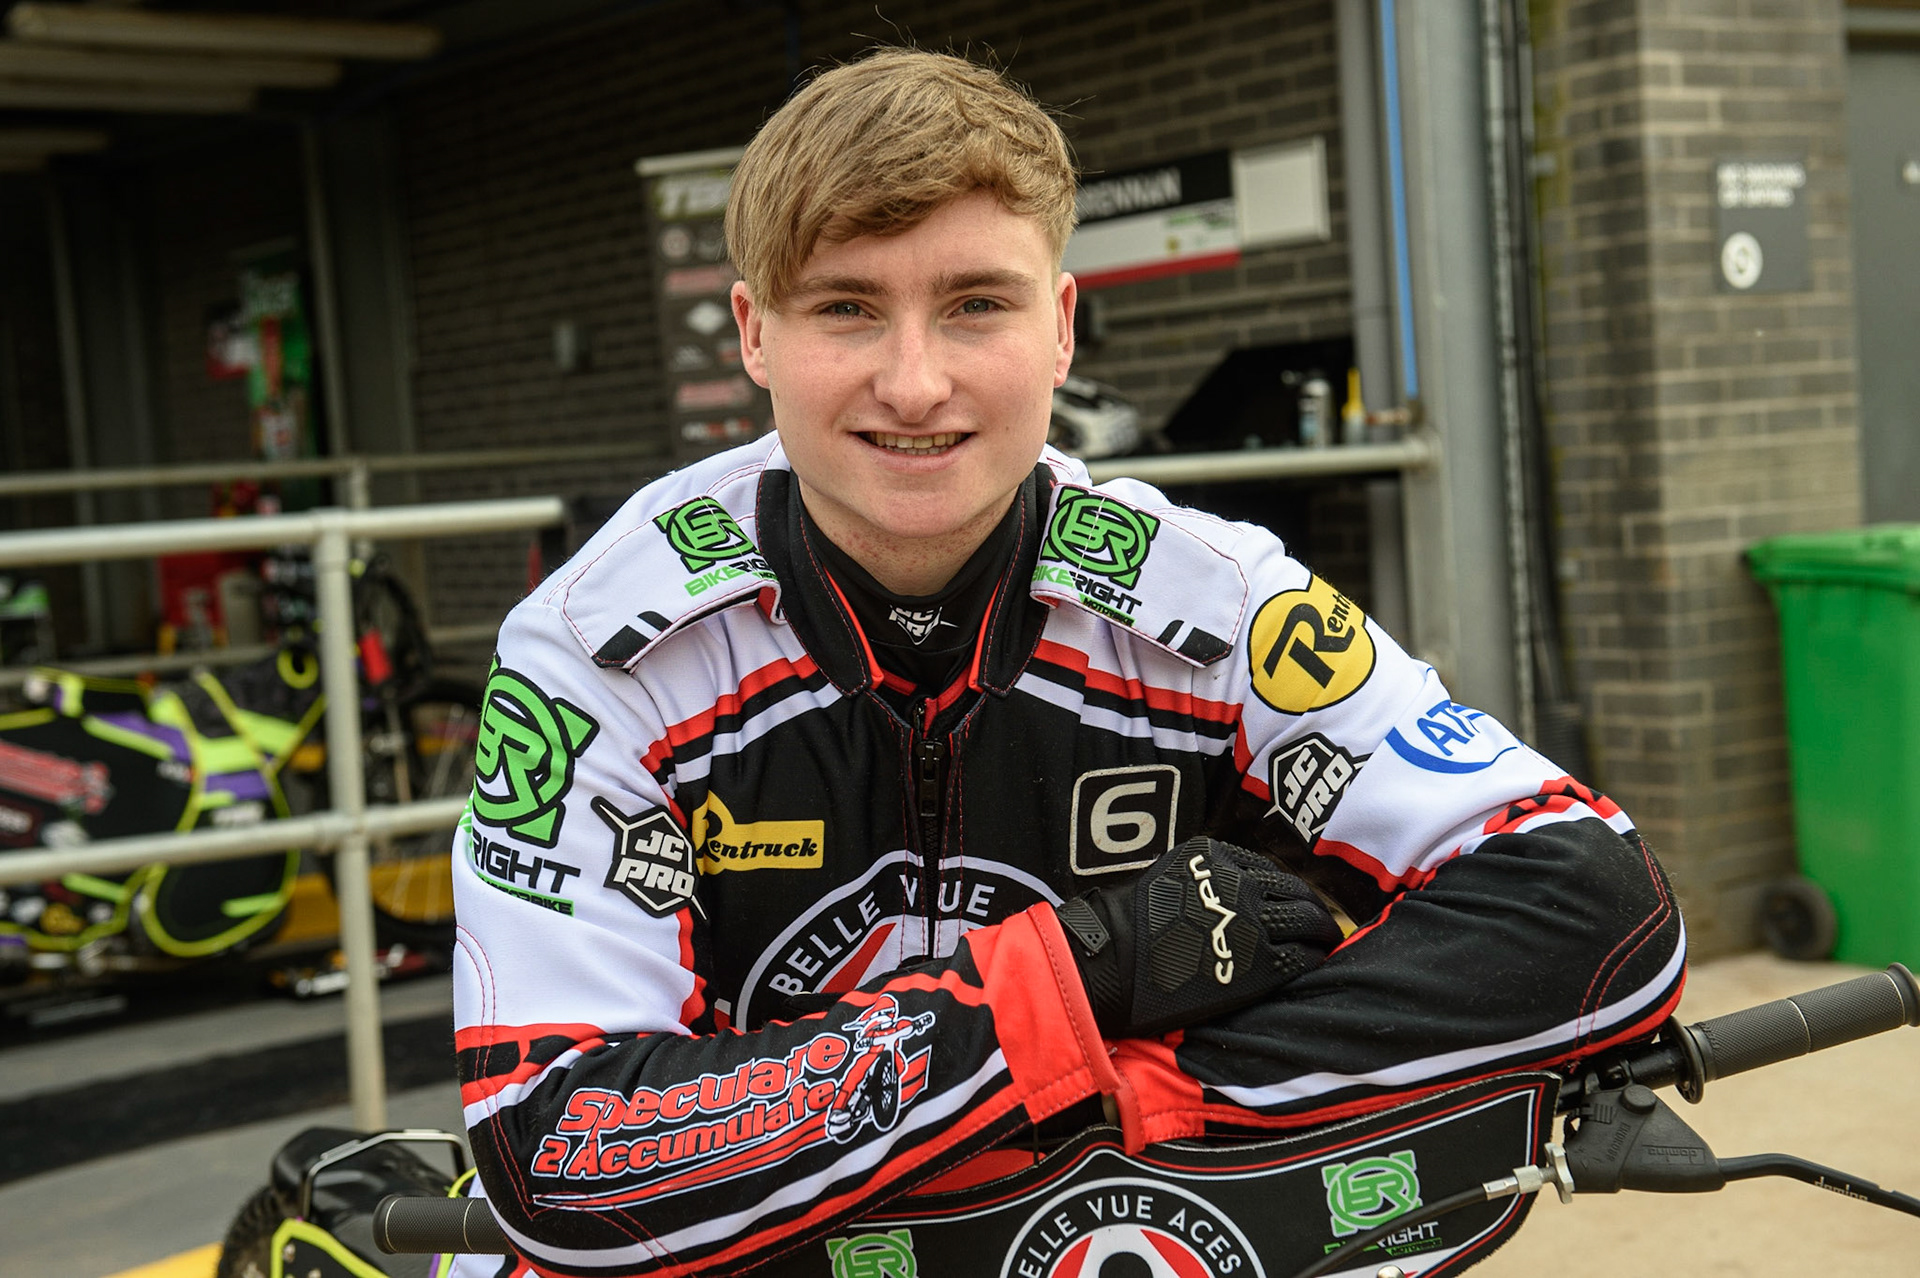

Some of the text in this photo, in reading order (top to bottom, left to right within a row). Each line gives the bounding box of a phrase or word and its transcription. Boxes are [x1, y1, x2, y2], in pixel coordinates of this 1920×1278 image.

[684, 558, 771, 597] BIKERIG
[1283, 746, 1319, 809] JC
[1294, 752, 1354, 843] PRO
[634, 829, 686, 862] JC
[697, 809, 817, 863] Rentruck
[1090, 781, 1157, 854] 6
[613, 857, 695, 898] PRO
[768, 873, 995, 997] BELLE VUE
[557, 1034, 849, 1141] Speculate
[532, 1080, 837, 1176] 2 Accumulate
[1018, 1194, 1242, 1278] ELLE VUE ACES
